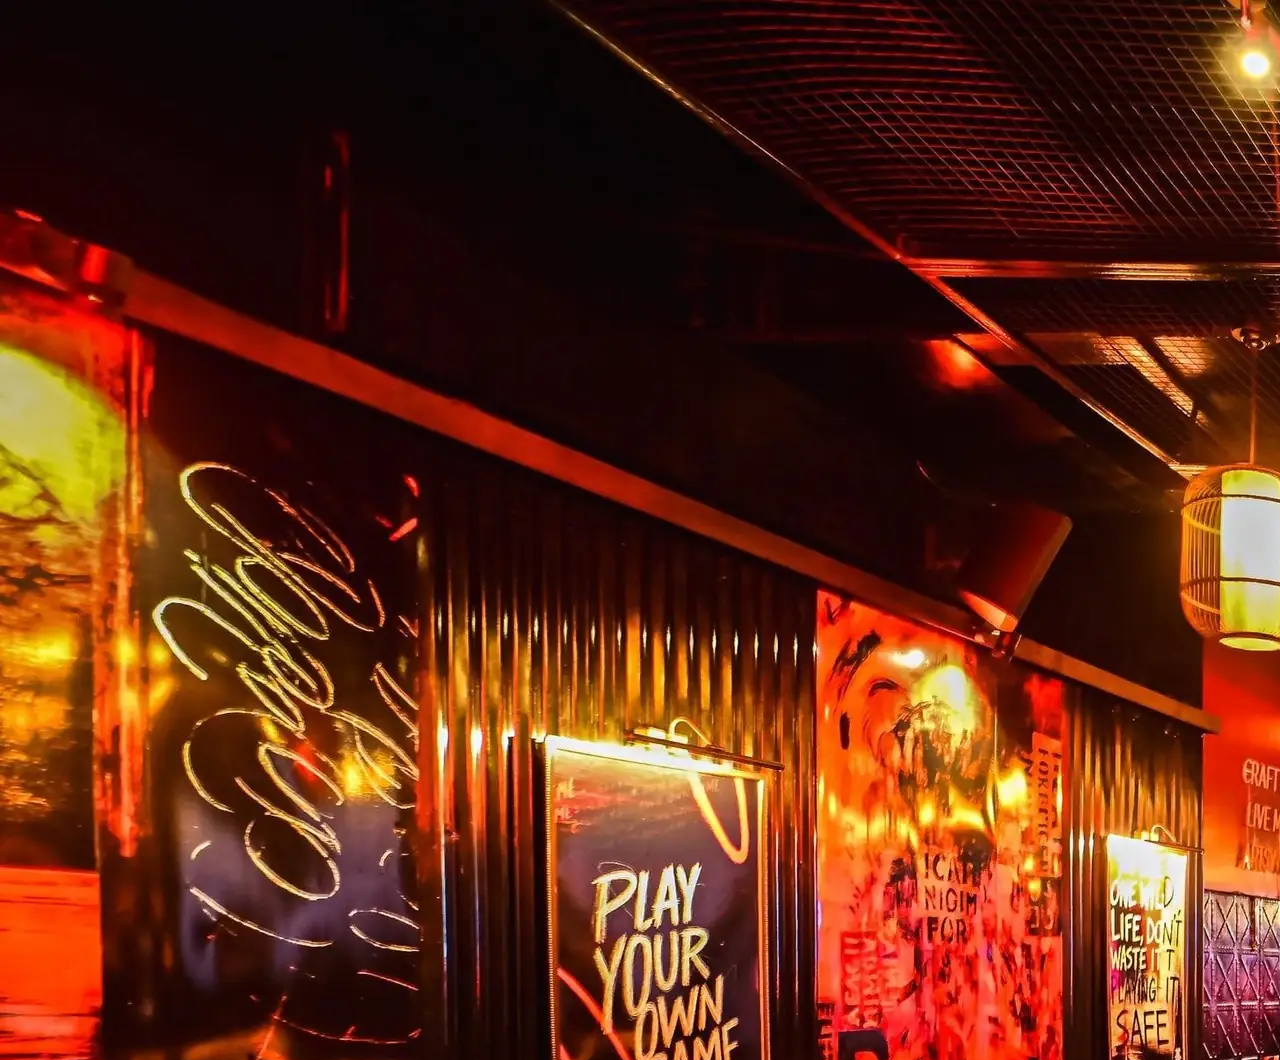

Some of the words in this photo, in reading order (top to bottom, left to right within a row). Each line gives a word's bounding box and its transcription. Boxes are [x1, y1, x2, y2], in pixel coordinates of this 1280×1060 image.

[1243, 758, 1280, 793] CRAFT
[1246, 801, 1271, 832] LIVE
[591, 861, 702, 943] PLAY
[1110, 907, 1144, 946] LIFE,
[1110, 945, 1147, 971] WASTE
[592, 926, 710, 1035] YOUR
[1111, 973, 1157, 1005] PLAYING
[1116, 1009, 1169, 1048] SAFE
